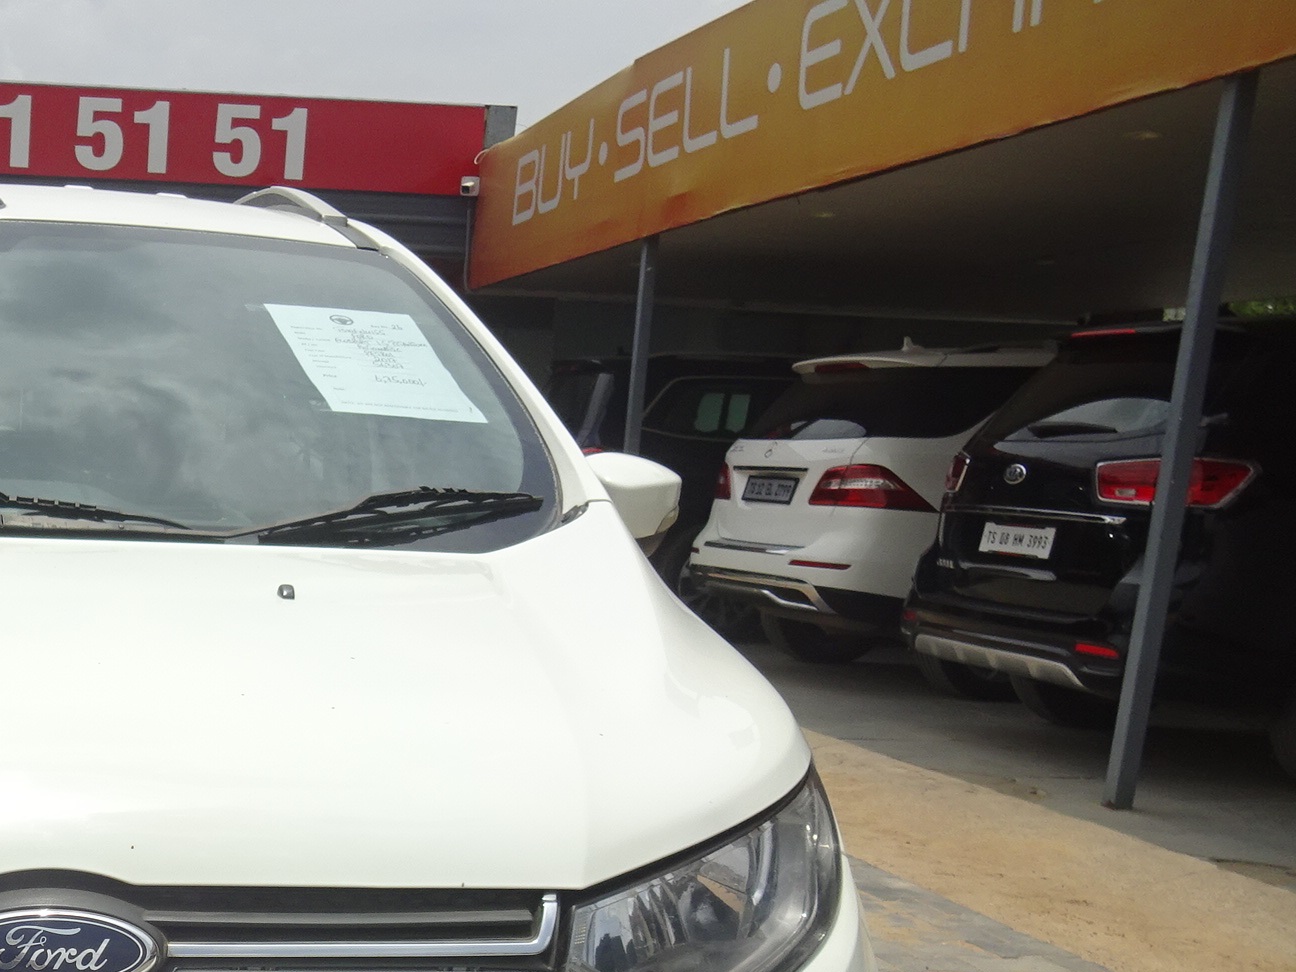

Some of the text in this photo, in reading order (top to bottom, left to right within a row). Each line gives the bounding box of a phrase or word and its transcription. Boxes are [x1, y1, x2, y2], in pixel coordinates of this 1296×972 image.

[74, 96, 170, 174] 51
[212, 103, 308, 180] 51
[512, 118, 594, 226] BUY
[614, 48, 759, 183] SELL
[987, 531, 997, 544] TS
